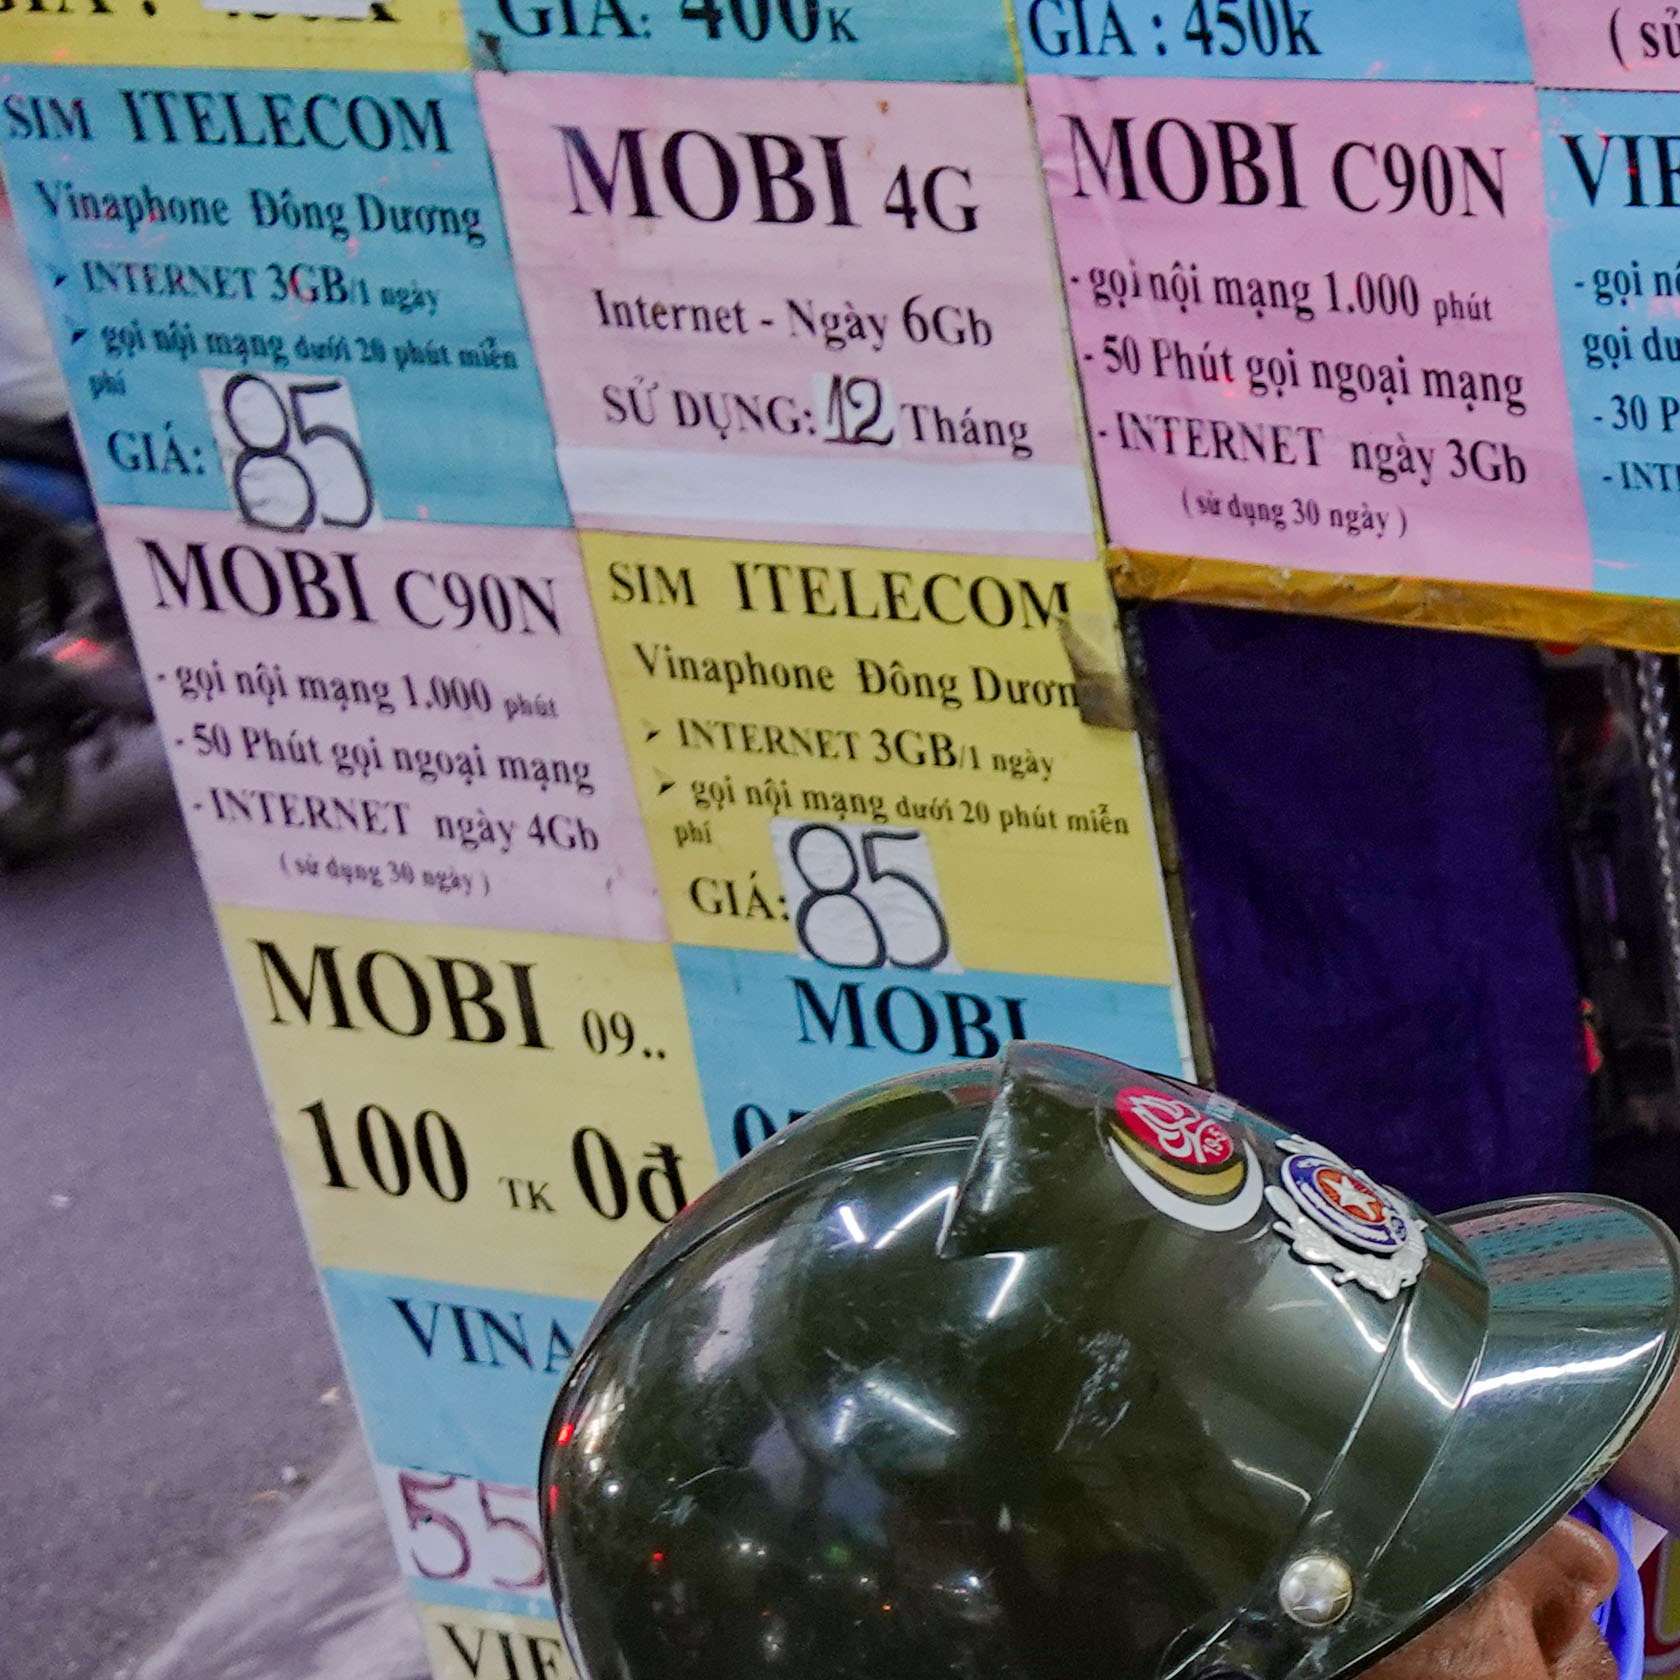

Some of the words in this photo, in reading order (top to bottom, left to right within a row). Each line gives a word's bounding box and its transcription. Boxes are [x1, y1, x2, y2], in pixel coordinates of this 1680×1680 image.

[4, 95, 94, 142] SIM
[120, 89, 452, 153] ITELECOM
[552, 125, 862, 228] MOBI
[885, 164, 979, 235] 4G
[1060, 113, 1307, 209] MOBI
[1332, 141, 1507, 218] C90N
[35, 180, 230, 233] Vinaphone
[359, 196, 486, 248] Dương
[82, 260, 257, 301] INTERNET
[1089, 259, 1141, 308] gọi
[1150, 262, 1200, 314] nội
[1214, 275, 1315, 323] mạng
[1324, 272, 1419, 317] 1.000
[1434, 292, 1493, 326] phút
[1592, 260, 1642, 306] gọi
[593, 288, 748, 335] Internet
[785, 298, 889, 352] Ngày
[904, 294, 992, 348] 6Gb
[1582, 326, 1632, 371] gọi
[1103, 335, 1141, 376] 50
[1151, 338, 1235, 384] Phút
[1247, 349, 1299, 399] gọi
[1313, 355, 1410, 403] ngoại
[1422, 366, 1527, 416] mạng
[822, 374, 893, 446] 12
[900, 403, 1034, 460] Tháng
[1610, 395, 1648, 431] 30
[223, 372, 375, 534] 85
[1116, 409, 1323, 467] INTERNET
[1351, 437, 1435, 487] ngày
[1449, 439, 1527, 485] 3Gb
[138, 538, 378, 625] MOBI
[395, 569, 562, 636] C90N
[608, 561, 696, 606] SIM
[731, 561, 1070, 630] ITELECOM
[634, 642, 835, 696] Vinaphone
[858, 659, 964, 710] Đông
[974, 664, 1080, 709] Dươn
[193, 723, 231, 758] 50
[241, 725, 321, 766] Phút
[331, 736, 381, 778] gọi
[394, 742, 487, 787] ngoại
[499, 755, 595, 794] mạng
[679, 718, 860, 761] INTERNET
[992, 750, 1055, 781] ngày
[208, 787, 411, 836] INTERNET
[435, 808, 516, 854] ngày
[527, 813, 600, 852] 4Gb
[691, 778, 735, 811] gọi
[745, 780, 792, 815] nội
[802, 791, 888, 824] mạng
[962, 802, 990, 825] 20
[1000, 804, 1056, 834] phút
[690, 870, 789, 922] GIÁ:
[789, 822, 950, 970] 85
[248, 938, 555, 1051] MOBI
[788, 975, 1029, 1060] MOBI
[300, 1099, 468, 1203] 100
[499, 1176, 556, 1214] TK
